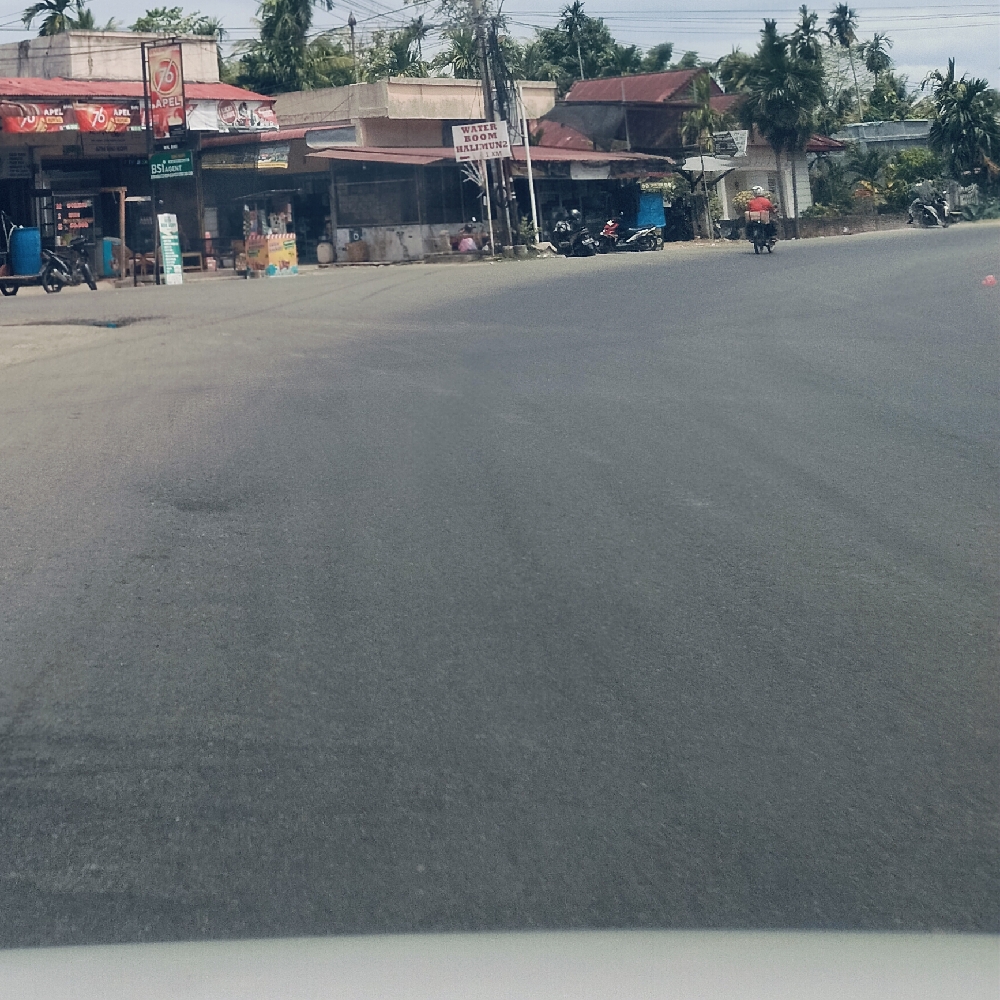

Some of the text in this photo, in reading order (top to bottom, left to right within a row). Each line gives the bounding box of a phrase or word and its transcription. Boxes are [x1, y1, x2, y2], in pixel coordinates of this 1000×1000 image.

[156, 96, 181, 107] APEL
[43, 108, 63, 116] APEL
[92, 106, 105, 127] 76
[113, 108, 131, 116] APEL
[460, 123, 497, 134] WATER
[464, 132, 497, 142] BOOM
